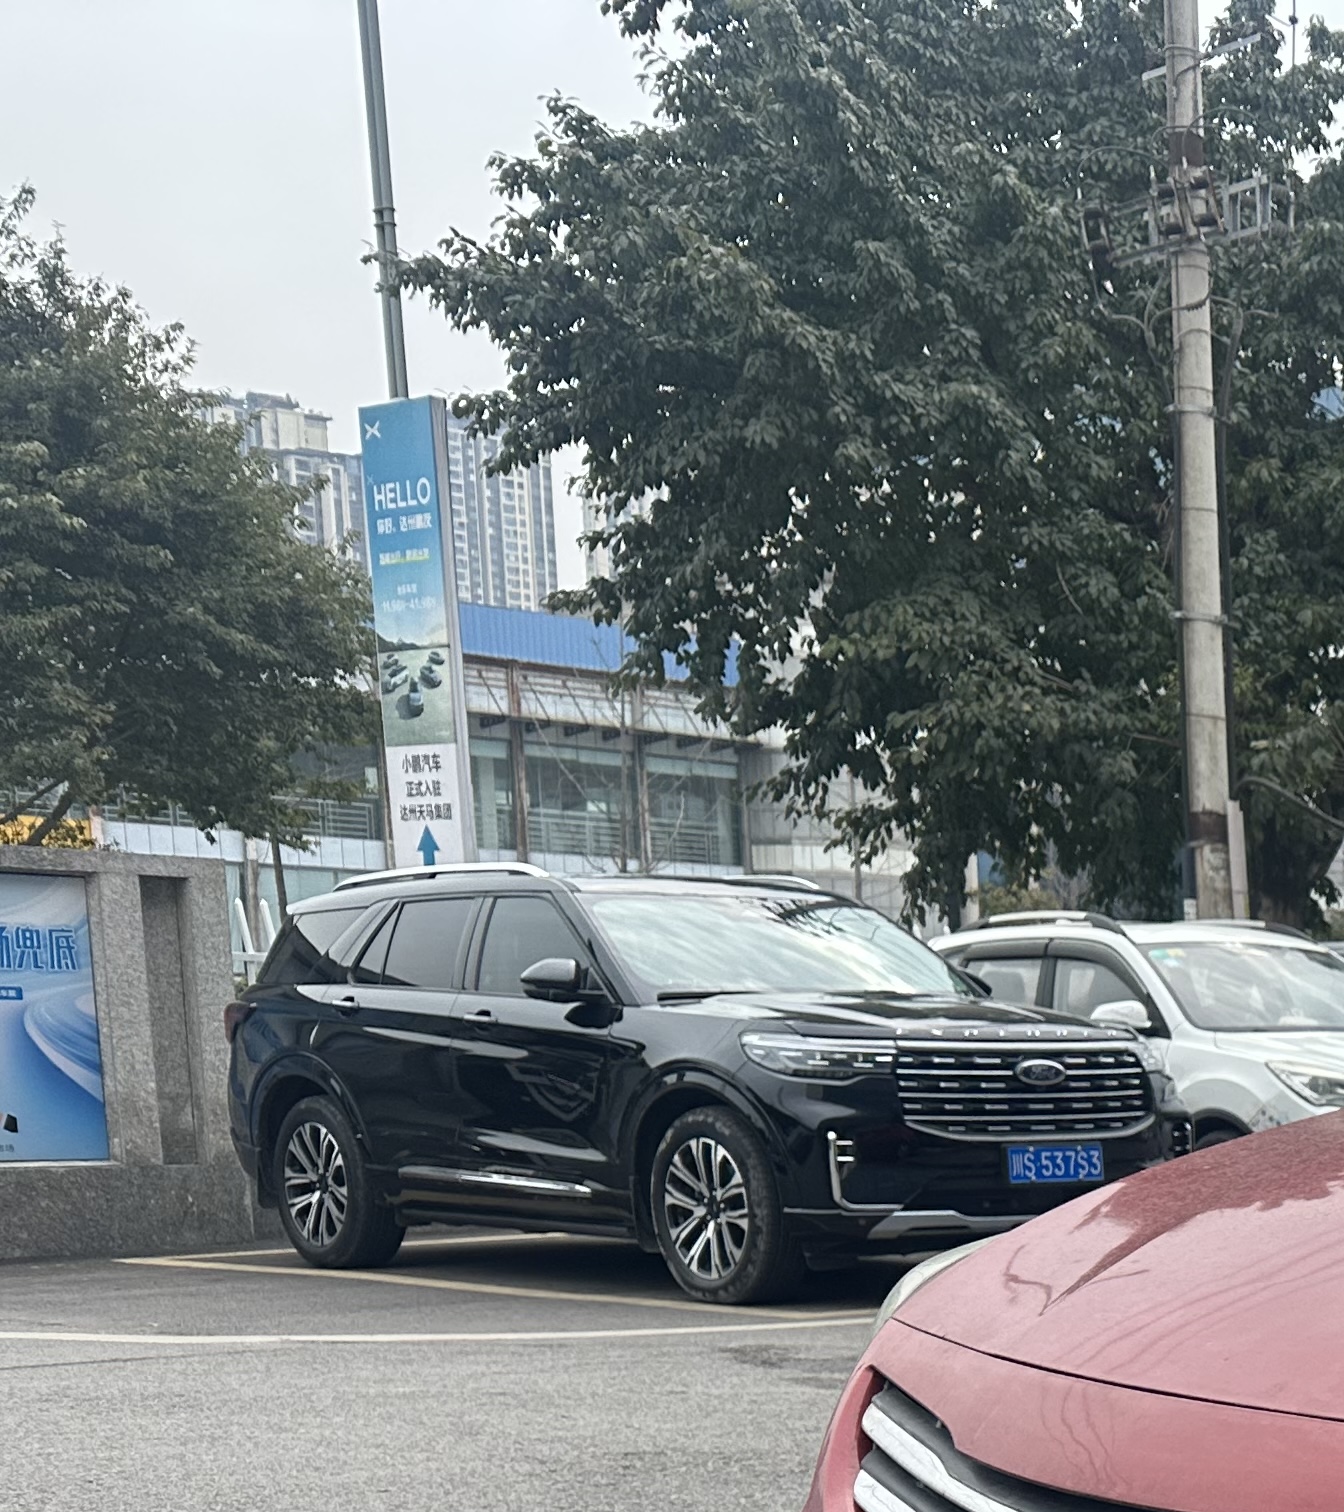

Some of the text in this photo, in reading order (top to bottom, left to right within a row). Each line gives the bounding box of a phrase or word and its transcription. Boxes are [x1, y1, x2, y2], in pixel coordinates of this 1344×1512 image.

[373, 477, 431, 511] HELLO
[401, 752, 441, 774] 小鹏汽车
[405, 780, 441, 798] 正式入驻
[400, 803, 452, 821] 达州天马集团
